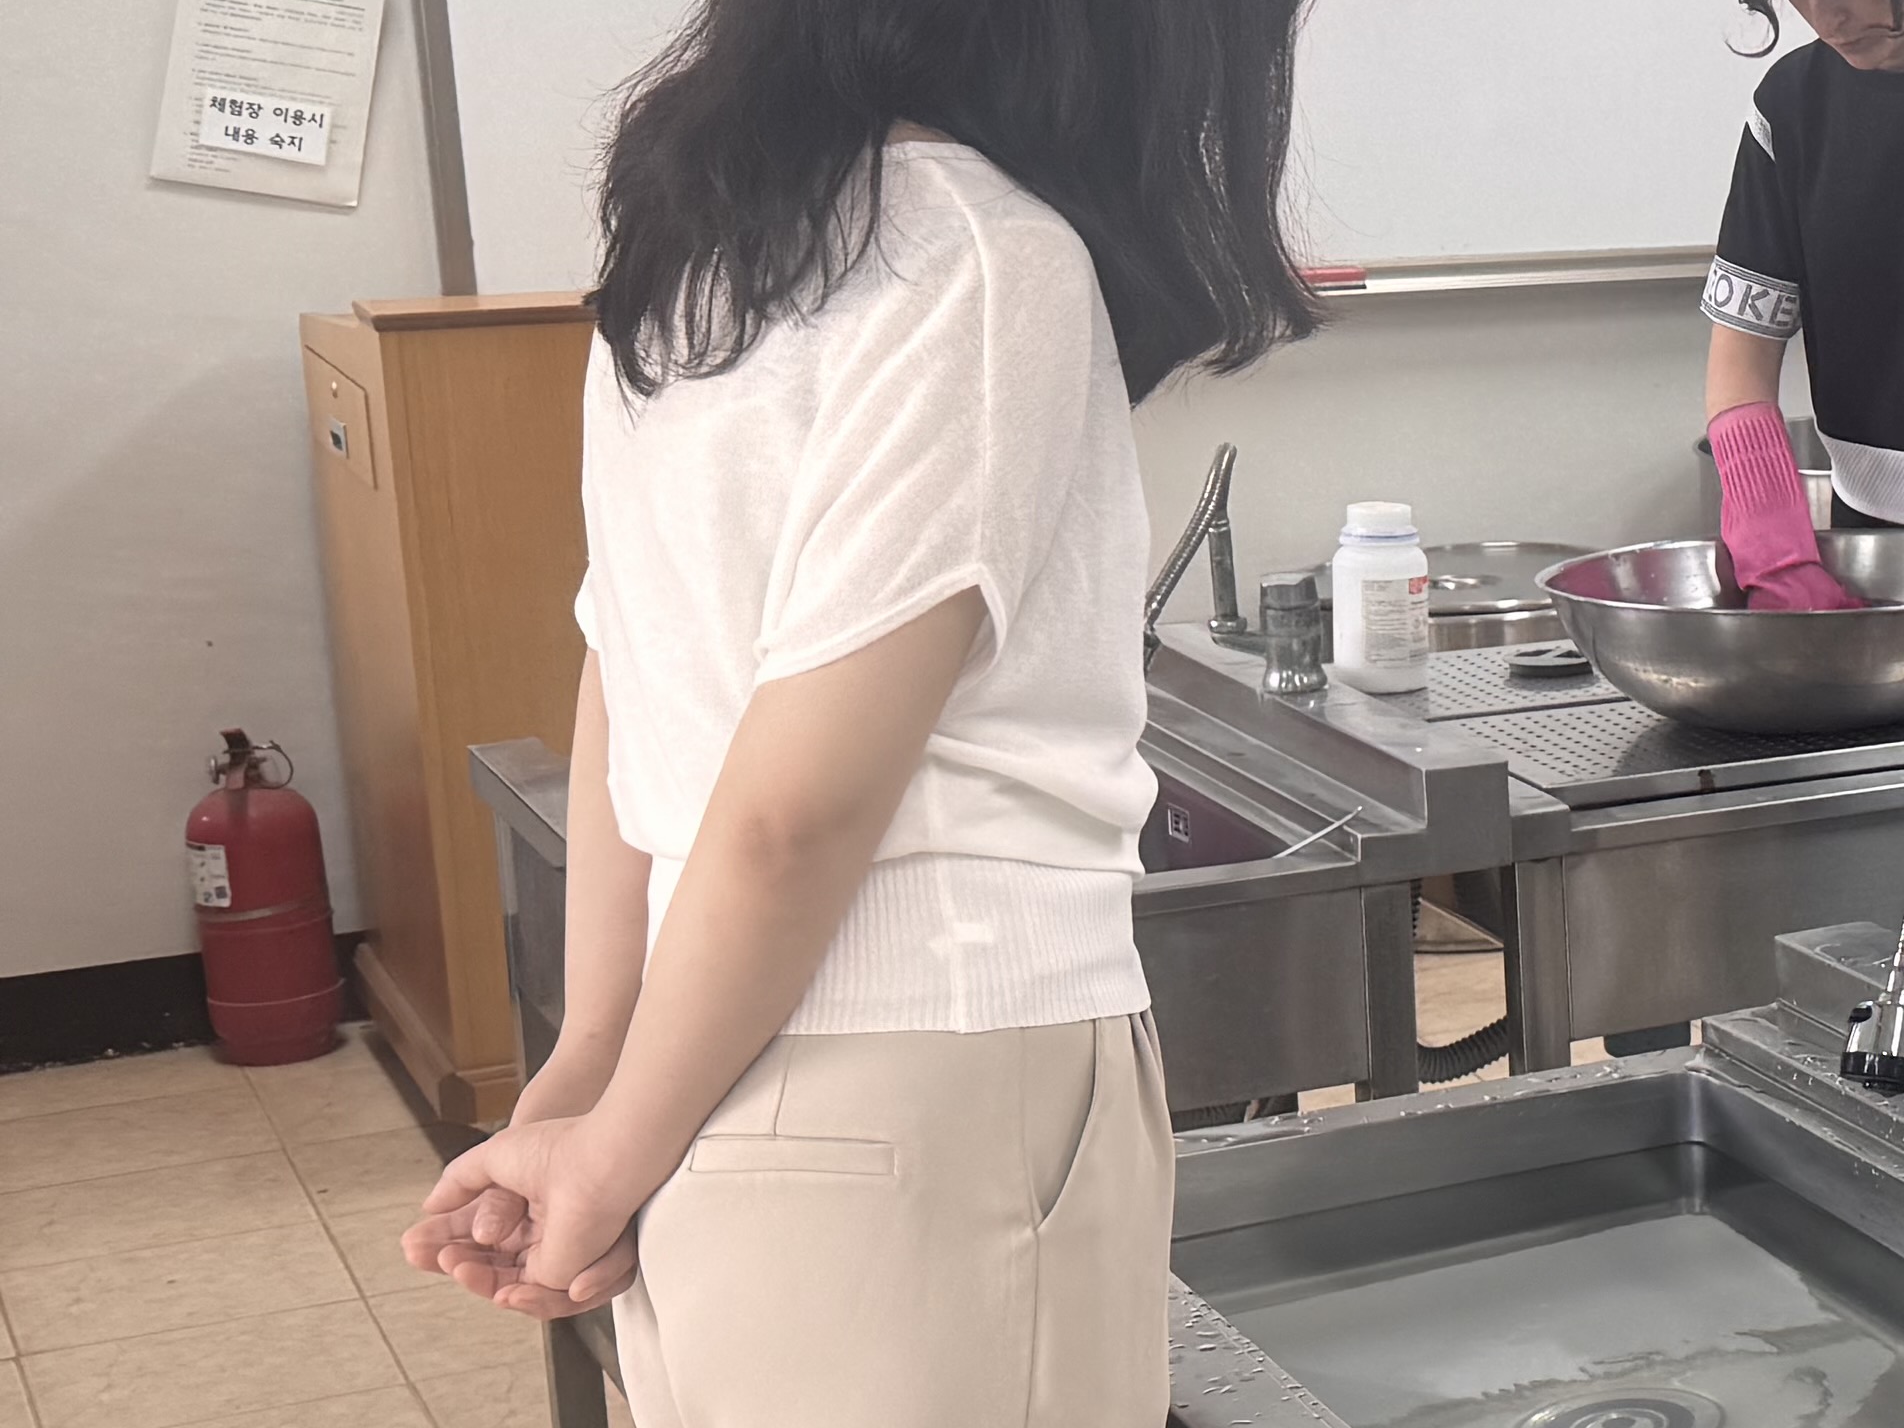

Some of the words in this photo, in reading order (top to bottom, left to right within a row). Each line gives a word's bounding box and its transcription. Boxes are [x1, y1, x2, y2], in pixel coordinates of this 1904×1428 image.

[209, 95, 264, 120] 체험장
[272, 107, 324, 129] 이용시
[224, 125, 259, 145] 내용
[268, 132, 303, 152] 숙지
